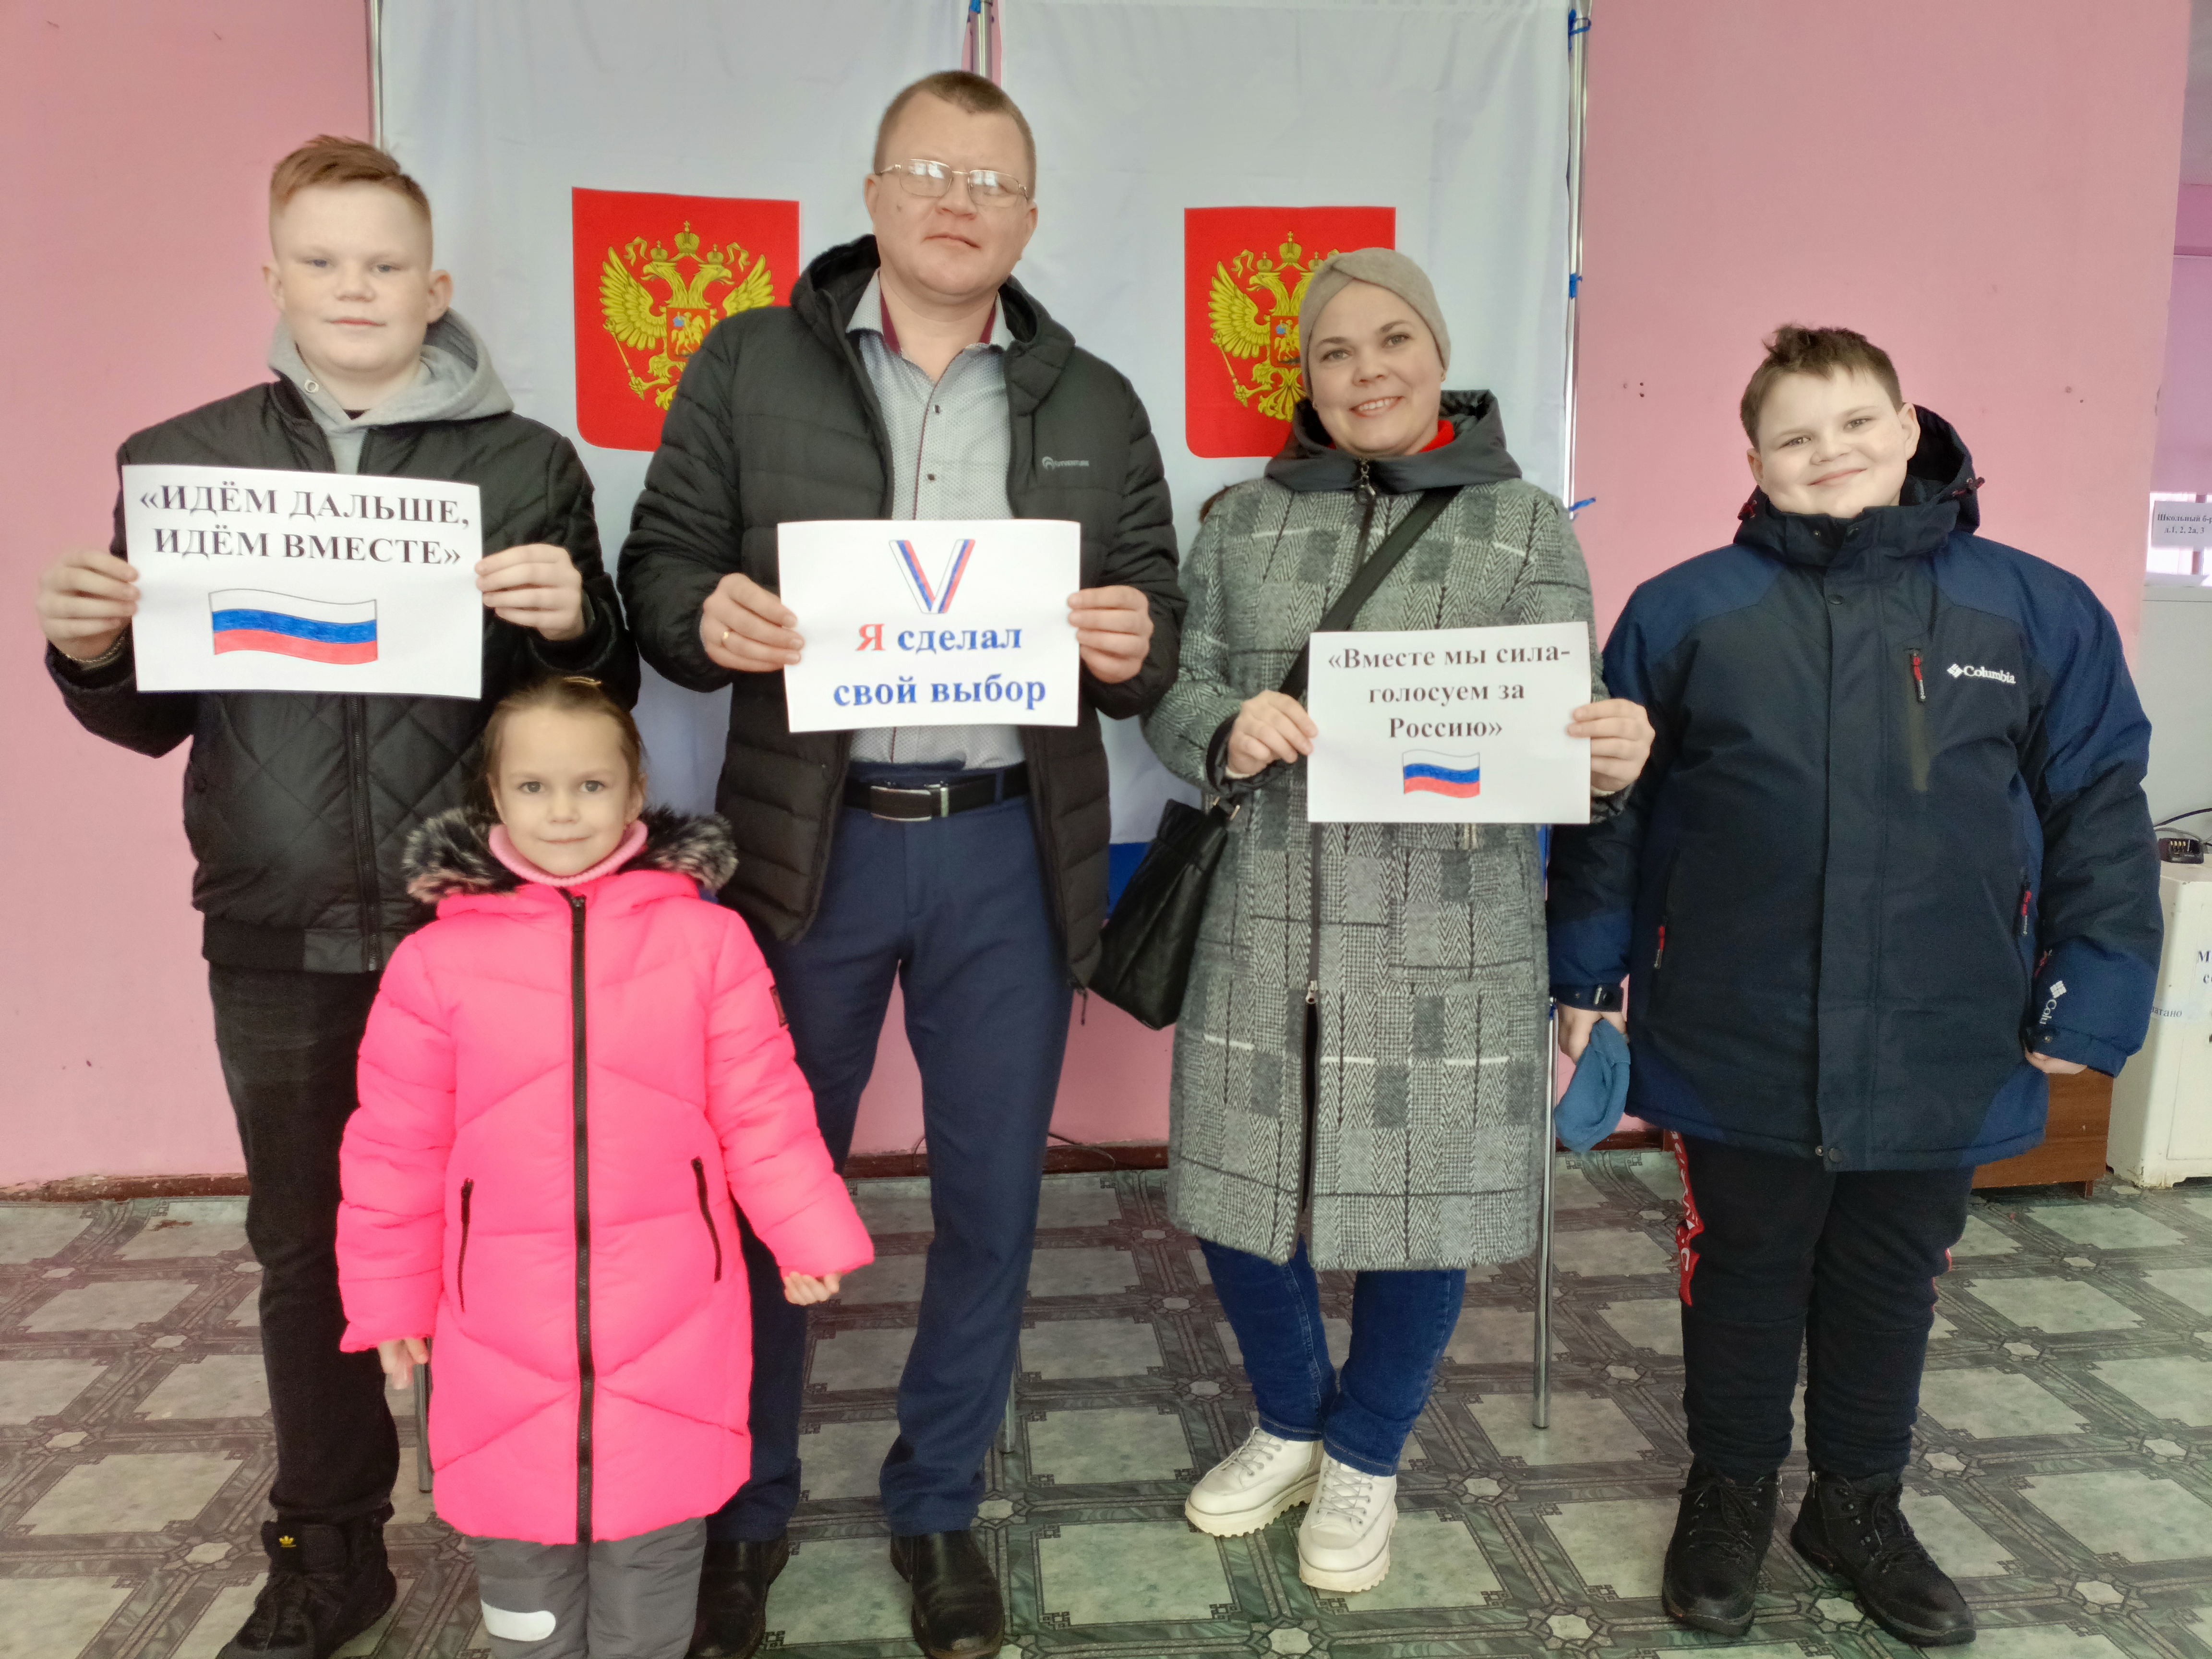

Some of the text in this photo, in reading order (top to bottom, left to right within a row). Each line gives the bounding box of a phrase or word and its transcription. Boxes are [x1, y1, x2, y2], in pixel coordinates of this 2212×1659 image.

[139, 481, 469, 527] «ИДЁМ ДАЛЬШЕ,
[2157, 513, 2200, 522] Школьный
[154, 524, 461, 565] ИДЁМ ВМЕСТЕ»
[856, 624, 1022, 654] Я сделал
[1328, 646, 1570, 668] «Вместе мы сила-
[1963, 666, 2016, 684] Columbia
[833, 673, 1046, 710] свой выбор
[1369, 684, 1525, 707] голосуем за
[1389, 718, 1503, 738] Россию»
